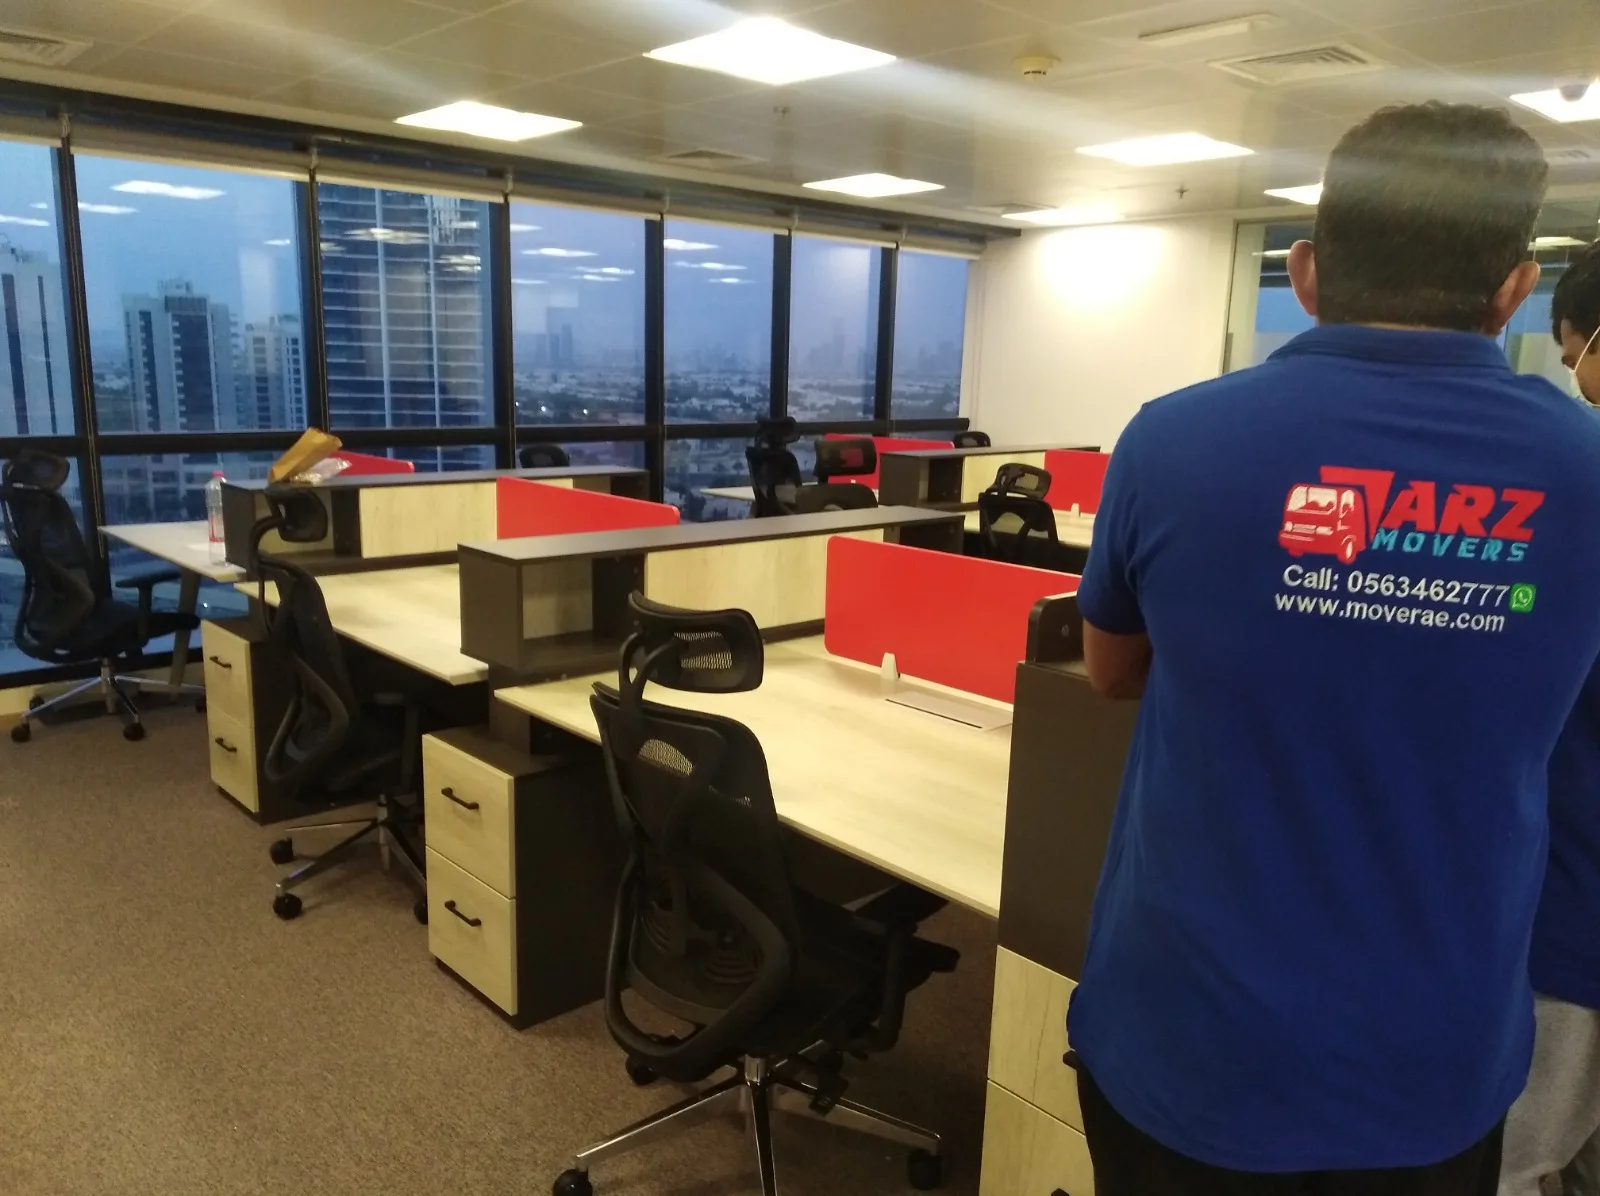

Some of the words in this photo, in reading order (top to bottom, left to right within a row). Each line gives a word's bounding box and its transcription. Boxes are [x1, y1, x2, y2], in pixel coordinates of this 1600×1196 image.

[1380, 480, 1546, 541] ARZ
[1372, 528, 1529, 561] MOVERS
[1283, 565, 1339, 592] Call:
[1347, 570, 1510, 607] 0563462777
[1275, 593, 1505, 632] www.moverae.com
